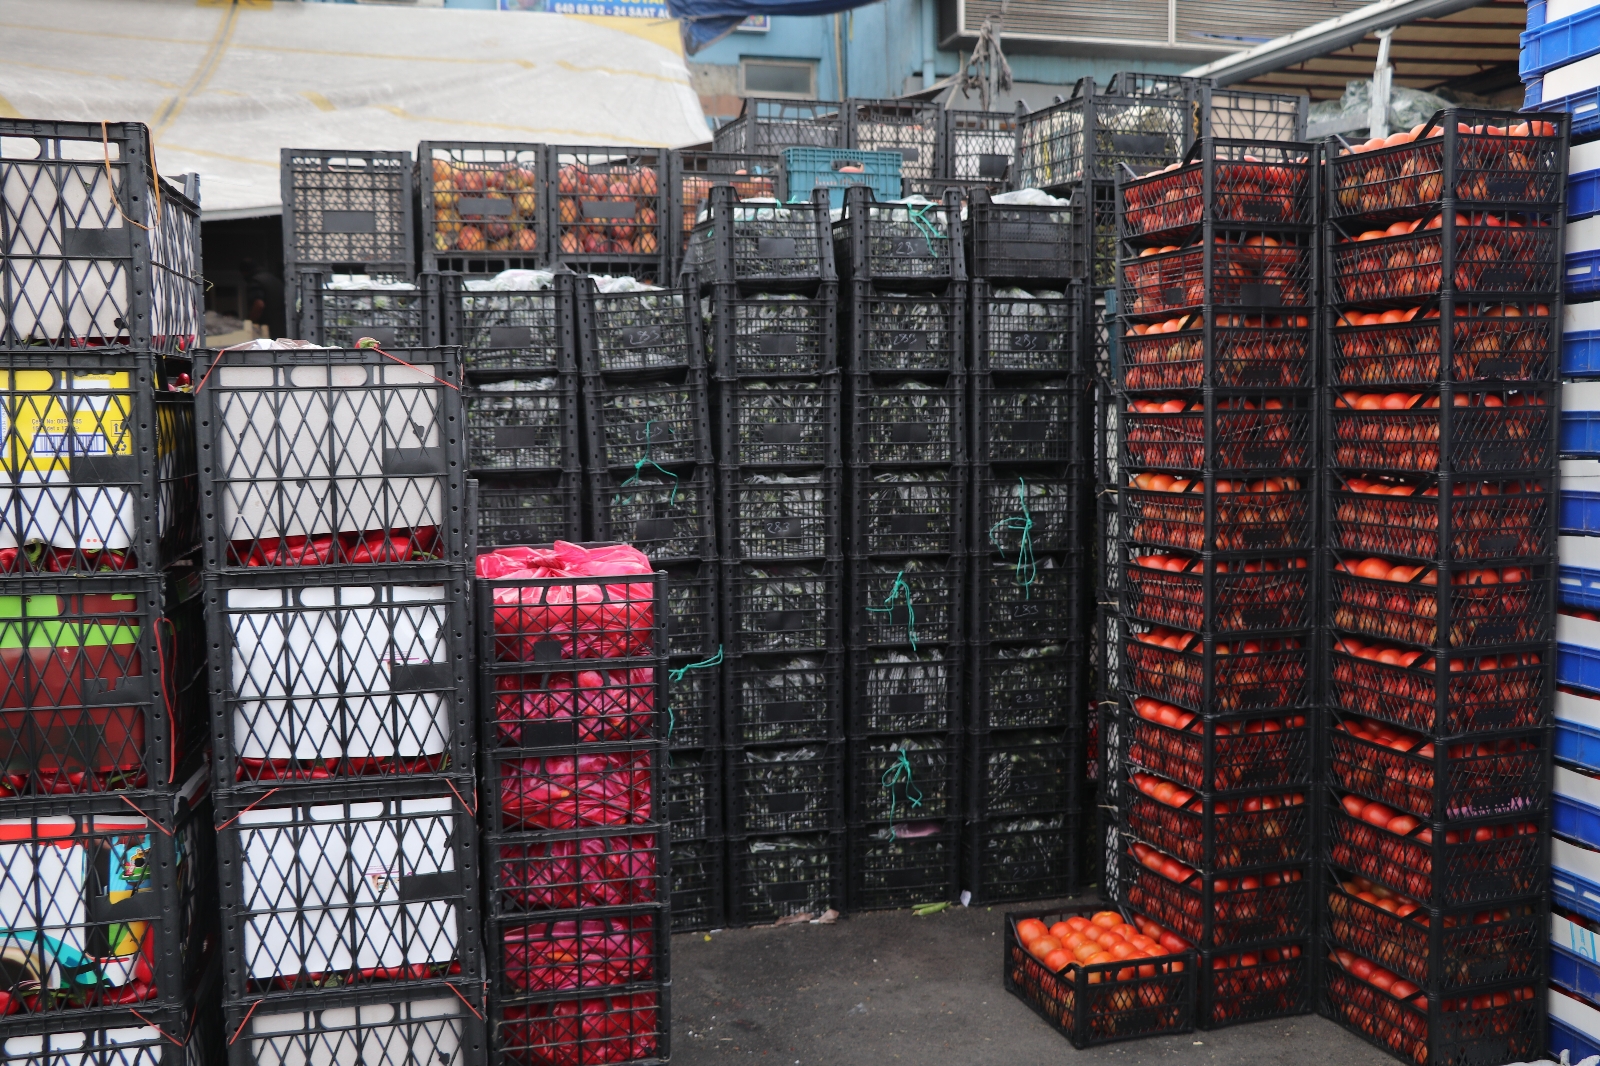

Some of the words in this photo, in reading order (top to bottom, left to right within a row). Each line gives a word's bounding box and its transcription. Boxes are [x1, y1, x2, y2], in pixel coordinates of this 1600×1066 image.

[613, 5, 627, 17] 24
[628, 6, 656, 18] SAAT
[766, 521, 791, 534] 283
[1013, 604, 1039, 618] 283
